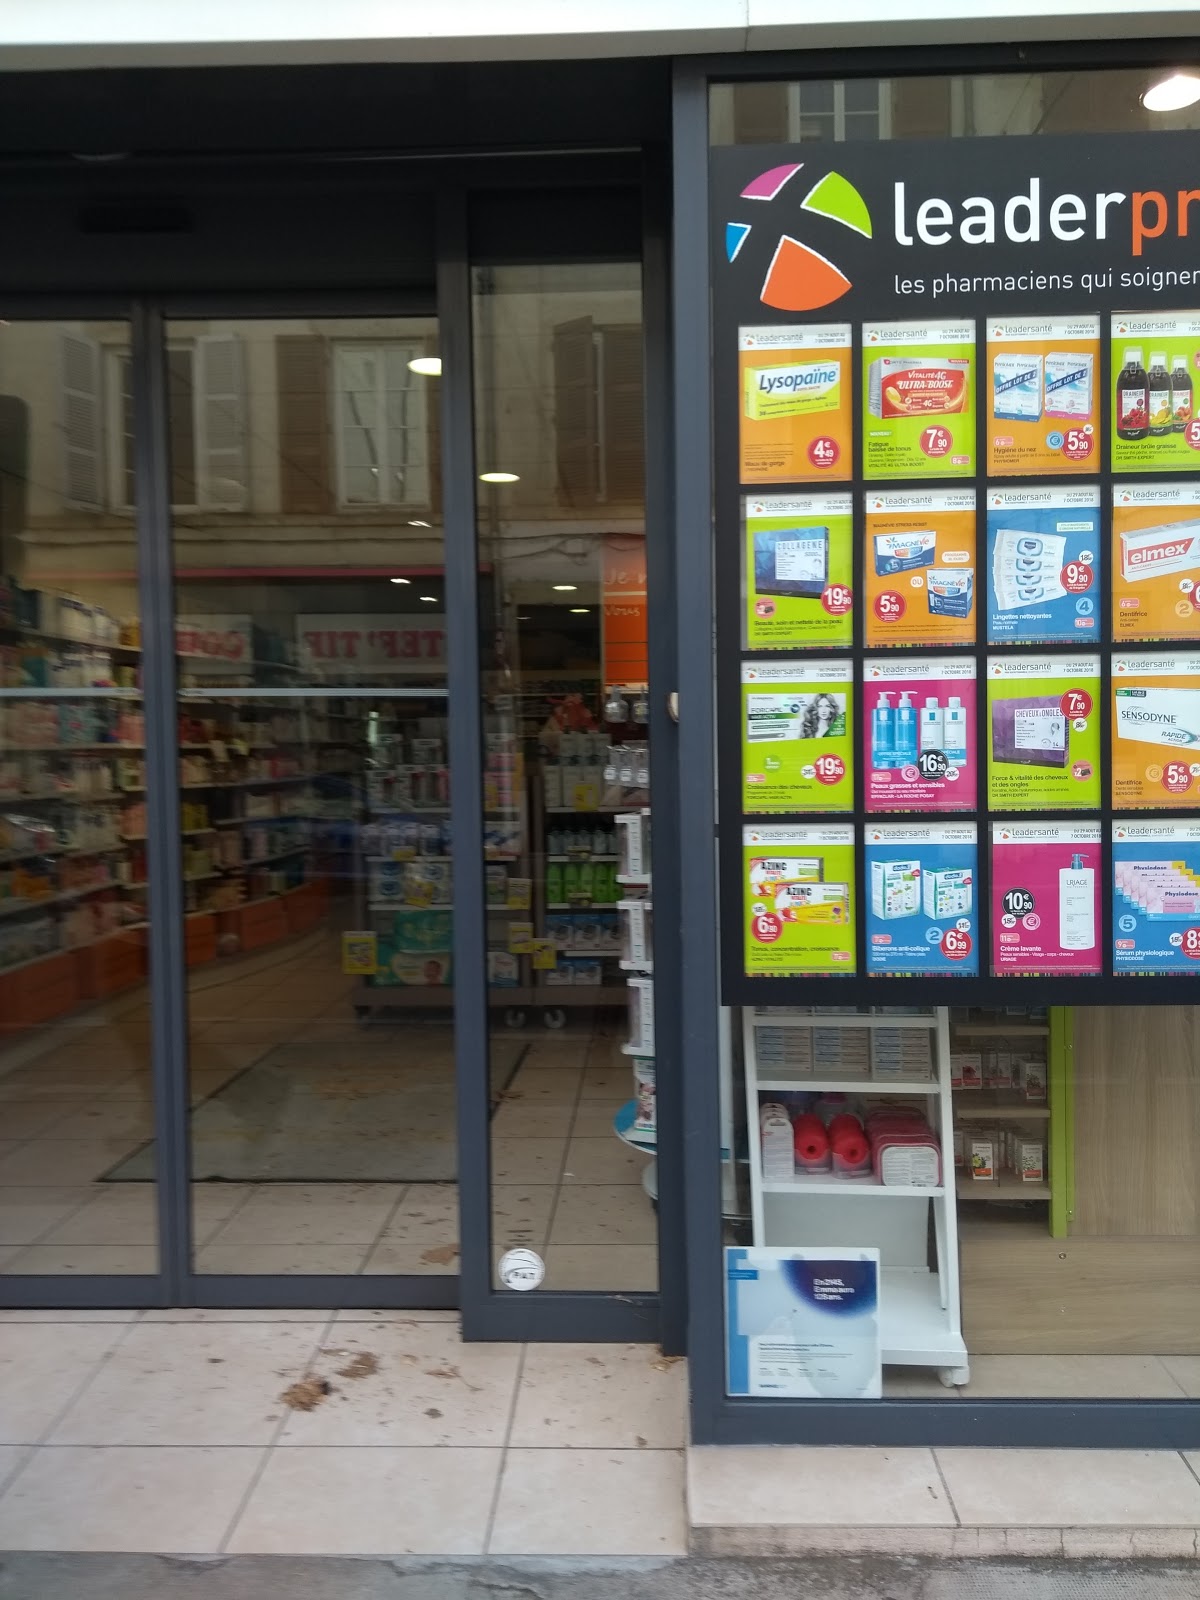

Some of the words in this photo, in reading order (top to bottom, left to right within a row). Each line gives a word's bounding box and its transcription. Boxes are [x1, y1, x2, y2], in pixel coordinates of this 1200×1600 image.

[895, 274, 925, 294] les
[933, 270, 1073, 298] pharmaciens
[1081, 268, 1112, 293] qui
[760, 368, 836, 394] Lysopaïne
[996, 382, 1011, 392] OFFRE
[1013, 377, 1023, 385] LOT
[1024, 373, 1032, 381] DE
[1047, 381, 1062, 392] OFFRE
[1064, 376, 1073, 384] LOT
[1131, 543, 1185, 563] elmex
[912, 577, 922, 585] OU
[1016, 710, 1039, 718] CHEVEUX
[1122, 710, 1176, 723] SENSODYNE
[1161, 731, 1186, 740] RAPIDE
[1123, 919, 1133, 930] 5
[930, 931, 939, 940] 2
